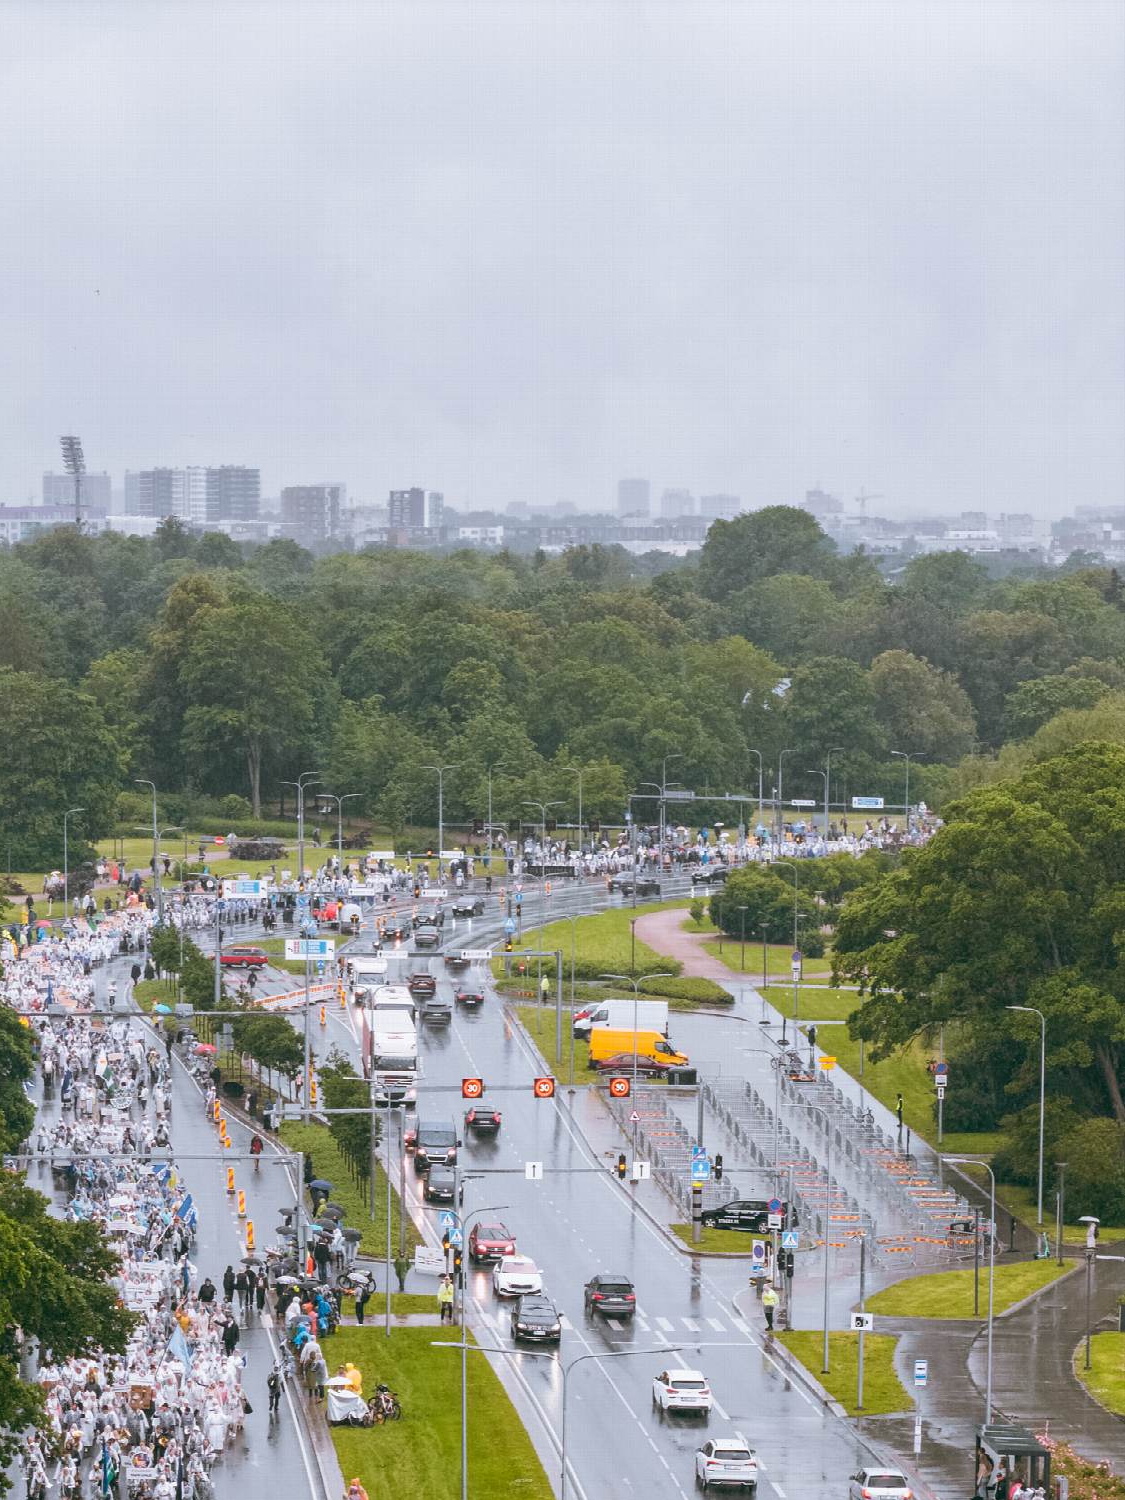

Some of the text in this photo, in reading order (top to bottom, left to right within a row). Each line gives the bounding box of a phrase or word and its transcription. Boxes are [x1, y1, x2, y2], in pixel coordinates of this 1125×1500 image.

[467, 1084, 478, 1093] 30
[539, 1083, 550, 1092] 30
[615, 1083, 626, 1092] 30
